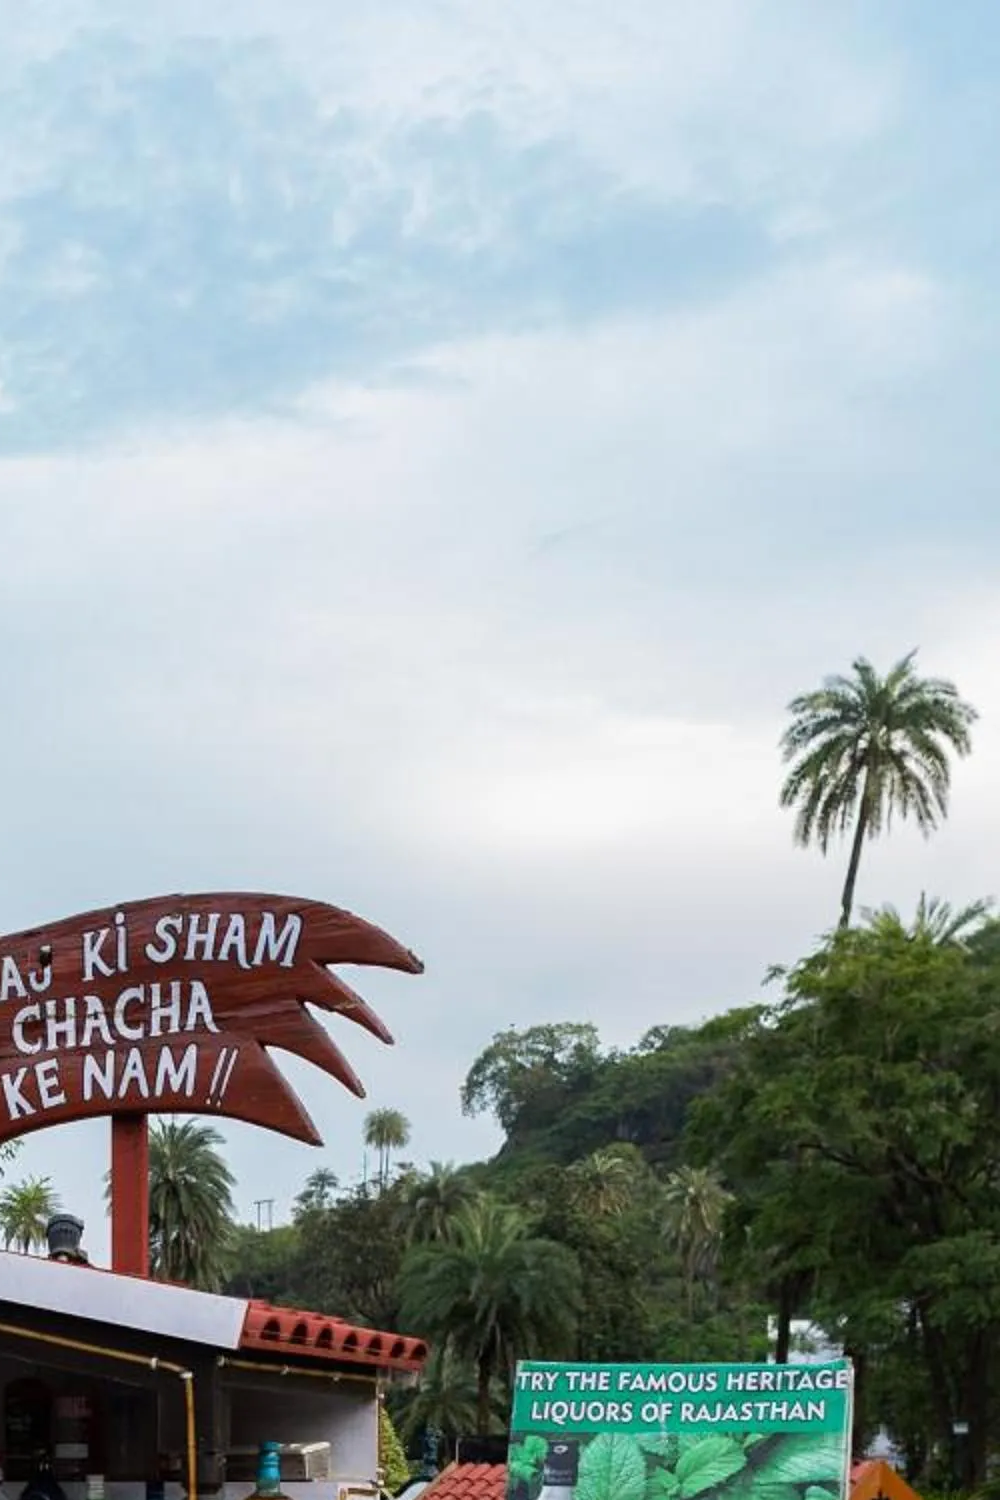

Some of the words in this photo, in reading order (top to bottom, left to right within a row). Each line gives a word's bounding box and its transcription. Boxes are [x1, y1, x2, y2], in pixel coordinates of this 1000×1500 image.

[145, 911, 303, 969] SHAM
[11, 980, 220, 1055] CHACHA
[1, 1057, 66, 1121] KE
[81, 1043, 198, 1101] NAM
[517, 1371, 559, 1391] TRY
[566, 1371, 611, 1391] THE
[618, 1371, 717, 1393] FAMOUS
[726, 1369, 849, 1391] HERITAGE
[531, 1401, 633, 1425] LIQUORS
[640, 1402, 673, 1422] OF
[681, 1400, 825, 1423] RAJASTHAN
